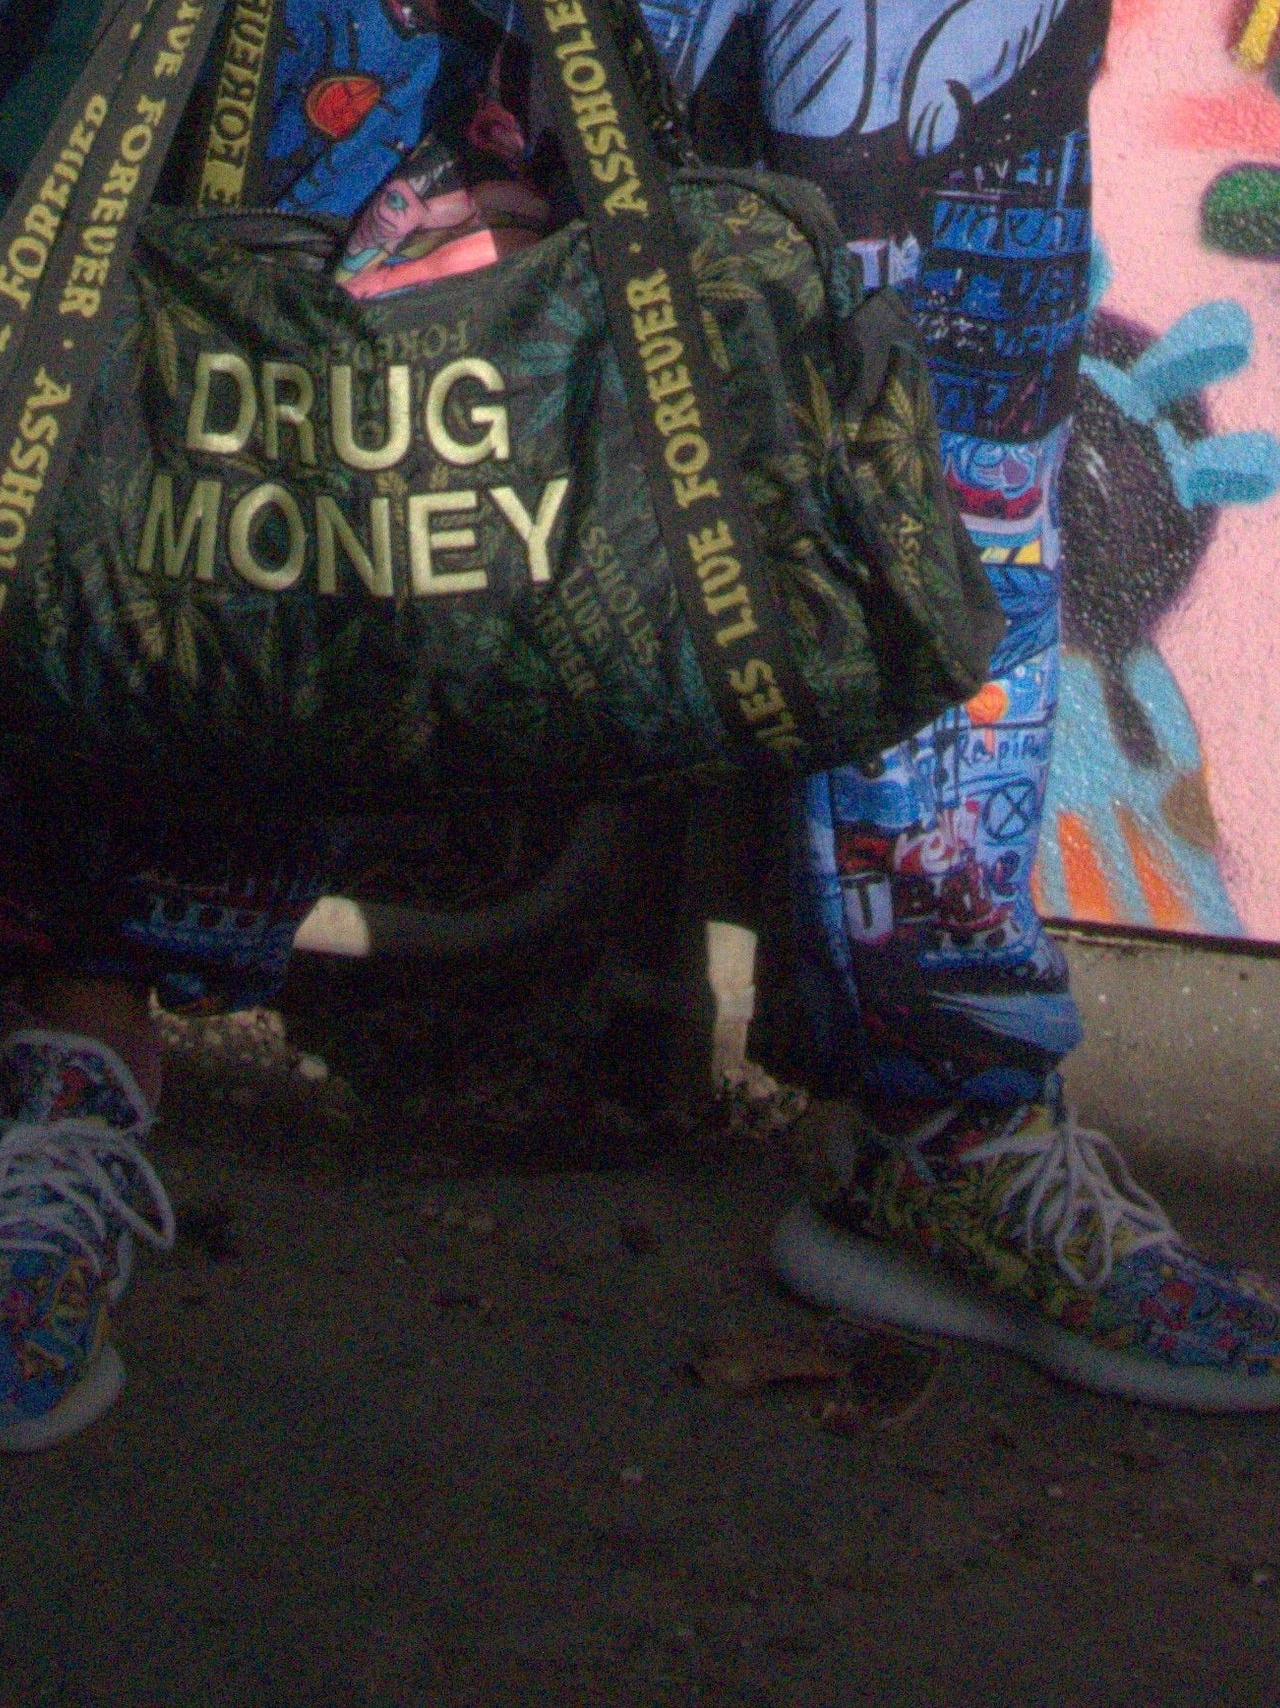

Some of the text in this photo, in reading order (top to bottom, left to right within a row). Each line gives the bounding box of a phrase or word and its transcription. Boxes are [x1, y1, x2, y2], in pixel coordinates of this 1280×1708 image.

[59, 94, 166, 319] FOREVER
[185, 351, 509, 471] DRUG
[626, 267, 719, 510] FOREVER
[136, 473, 569, 597] MONEY
